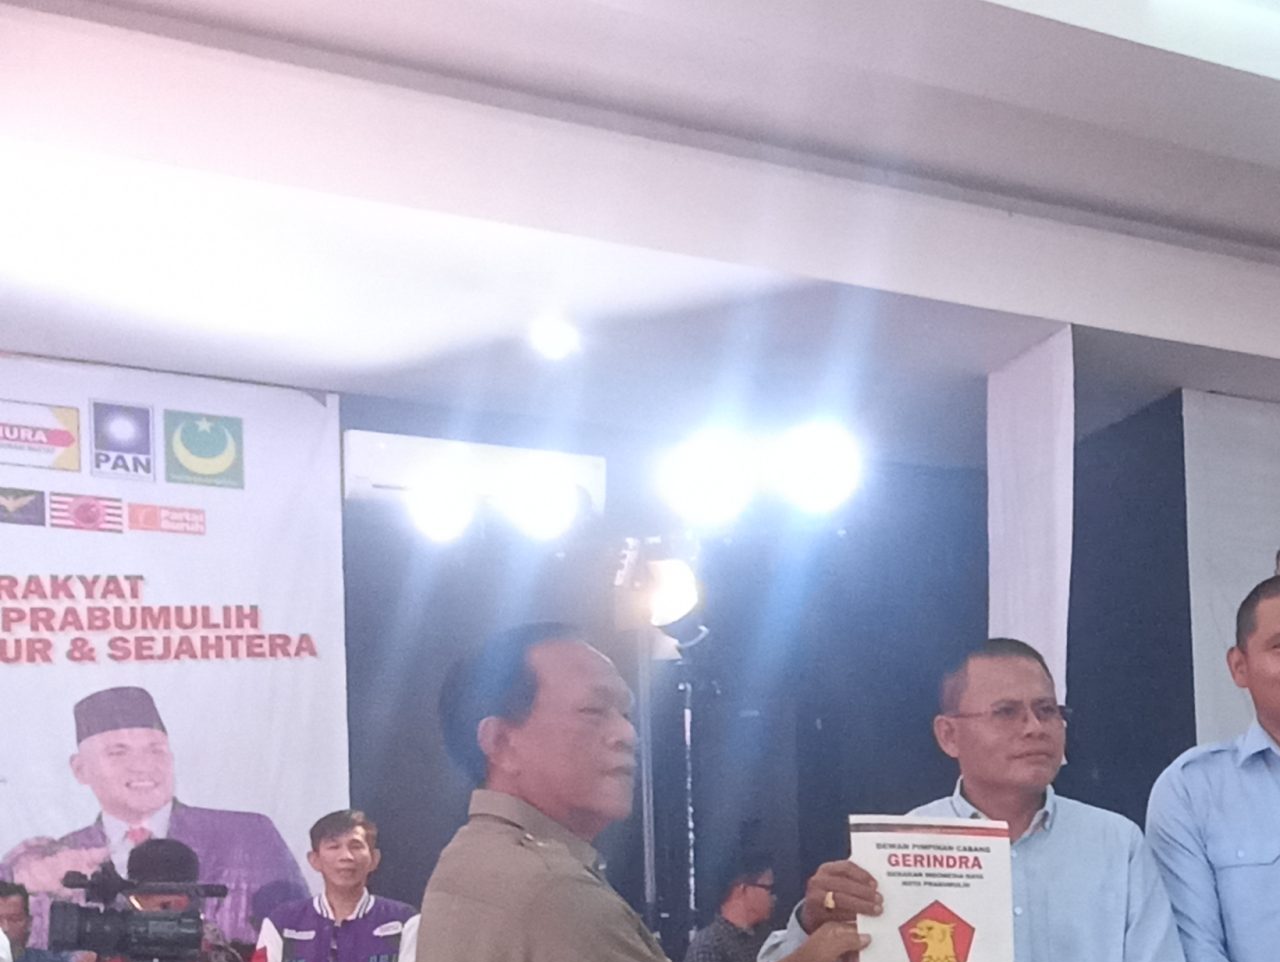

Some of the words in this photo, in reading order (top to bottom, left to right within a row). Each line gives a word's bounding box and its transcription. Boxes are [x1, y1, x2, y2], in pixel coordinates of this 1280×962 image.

[94, 452, 151, 474] PAN
[0, 575, 144, 600] RAKYAT
[1, 605, 260, 633] PRABUMULIH
[66, 637, 97, 662] &
[107, 633, 319, 661] SEJAHTERA
[887, 853, 983, 870] GERINDRA
